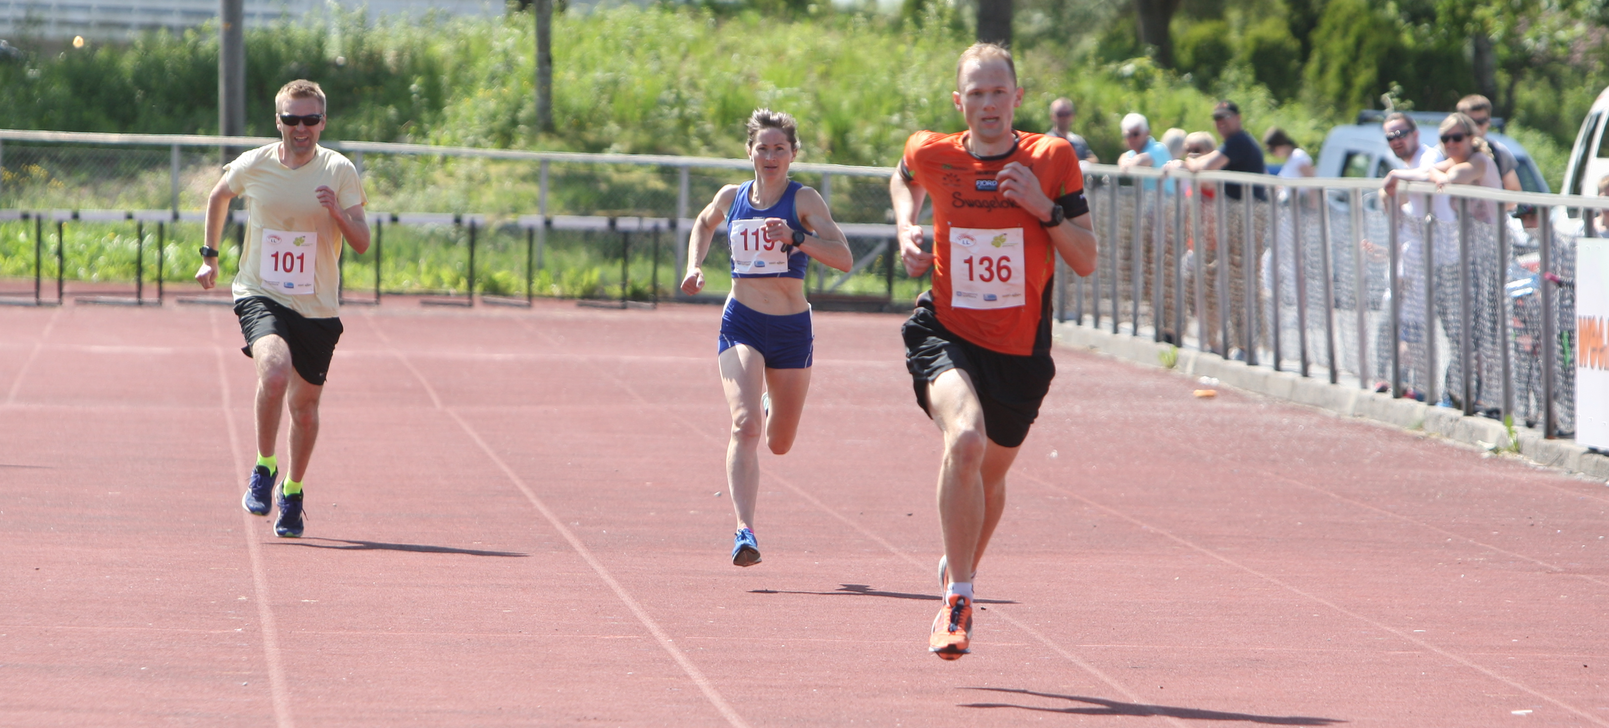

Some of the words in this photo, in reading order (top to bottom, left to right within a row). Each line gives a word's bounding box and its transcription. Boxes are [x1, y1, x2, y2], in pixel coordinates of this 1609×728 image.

[740, 228, 775, 251] 119
[270, 250, 305, 273] 101
[963, 255, 1012, 283] 136
